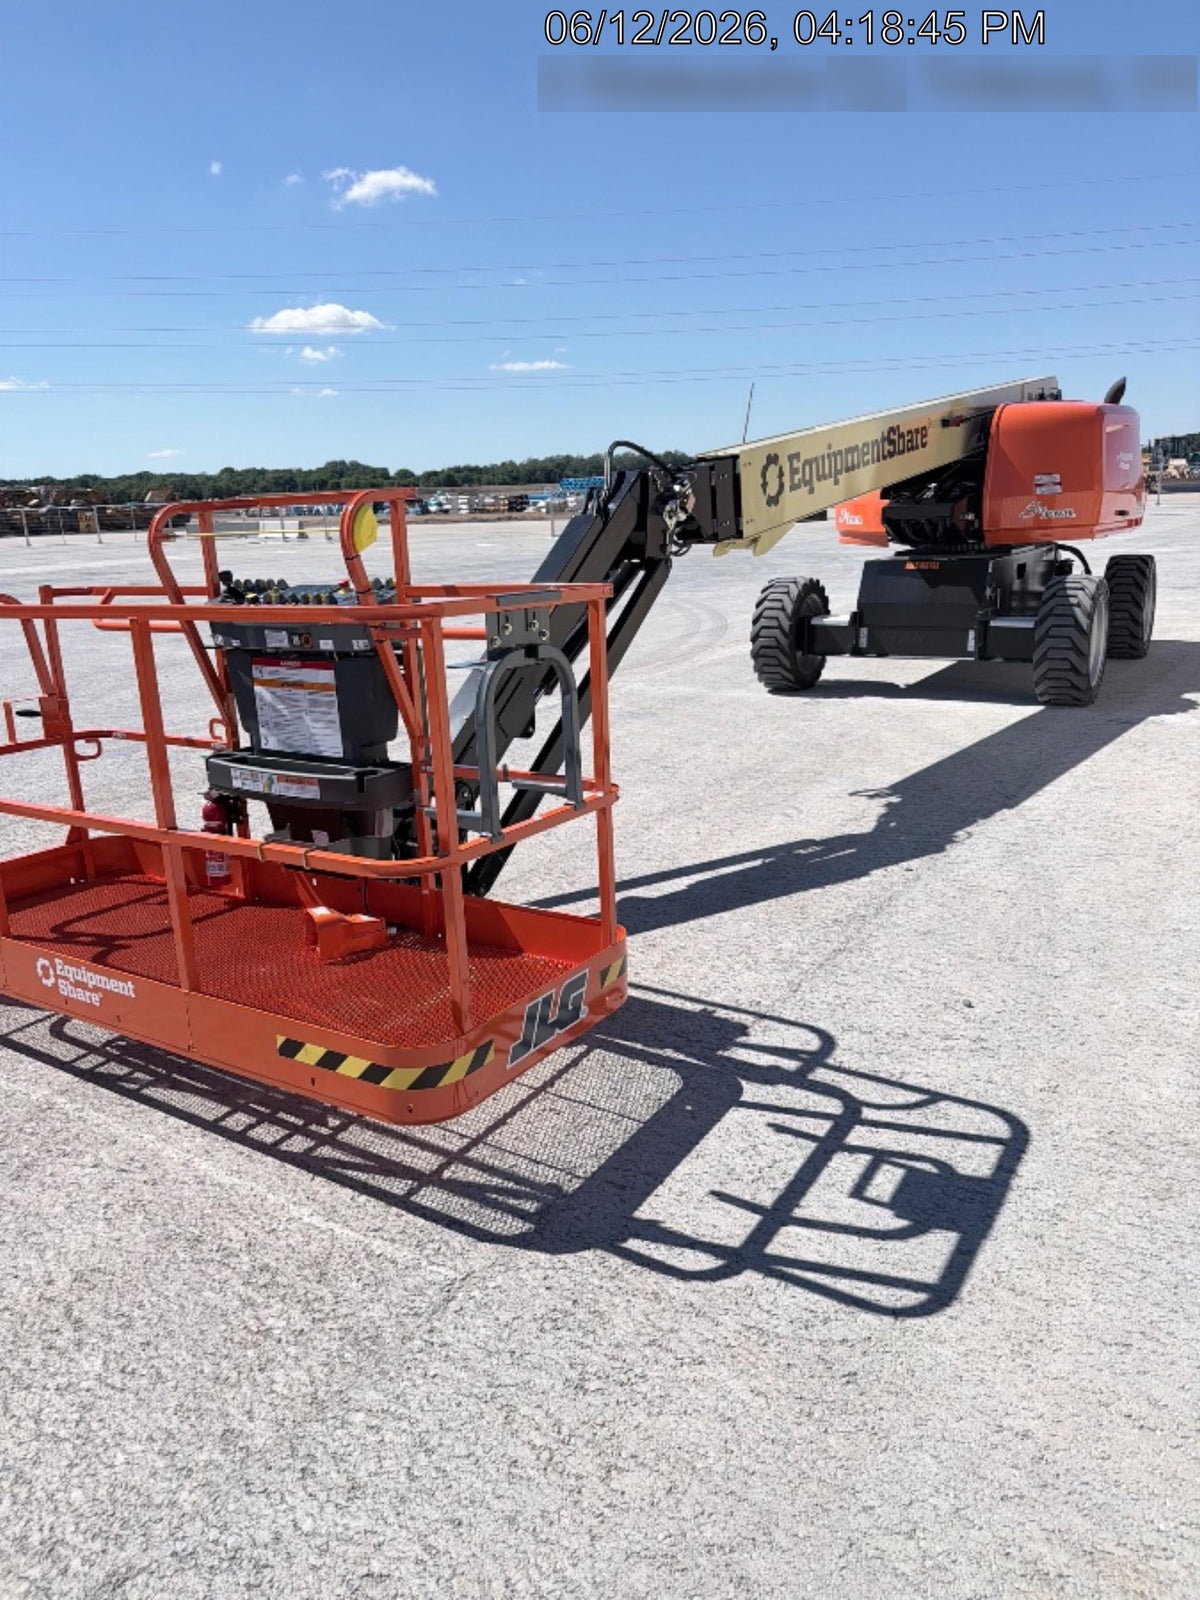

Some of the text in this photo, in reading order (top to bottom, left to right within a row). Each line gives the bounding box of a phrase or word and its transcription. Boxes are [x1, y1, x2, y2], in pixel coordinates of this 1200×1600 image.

[787, 424, 929, 495] EquipmentShare
[54, 958, 136, 998] Equipment
[58, 979, 101, 1007] Share
[506, 968, 589, 1070] JLG
